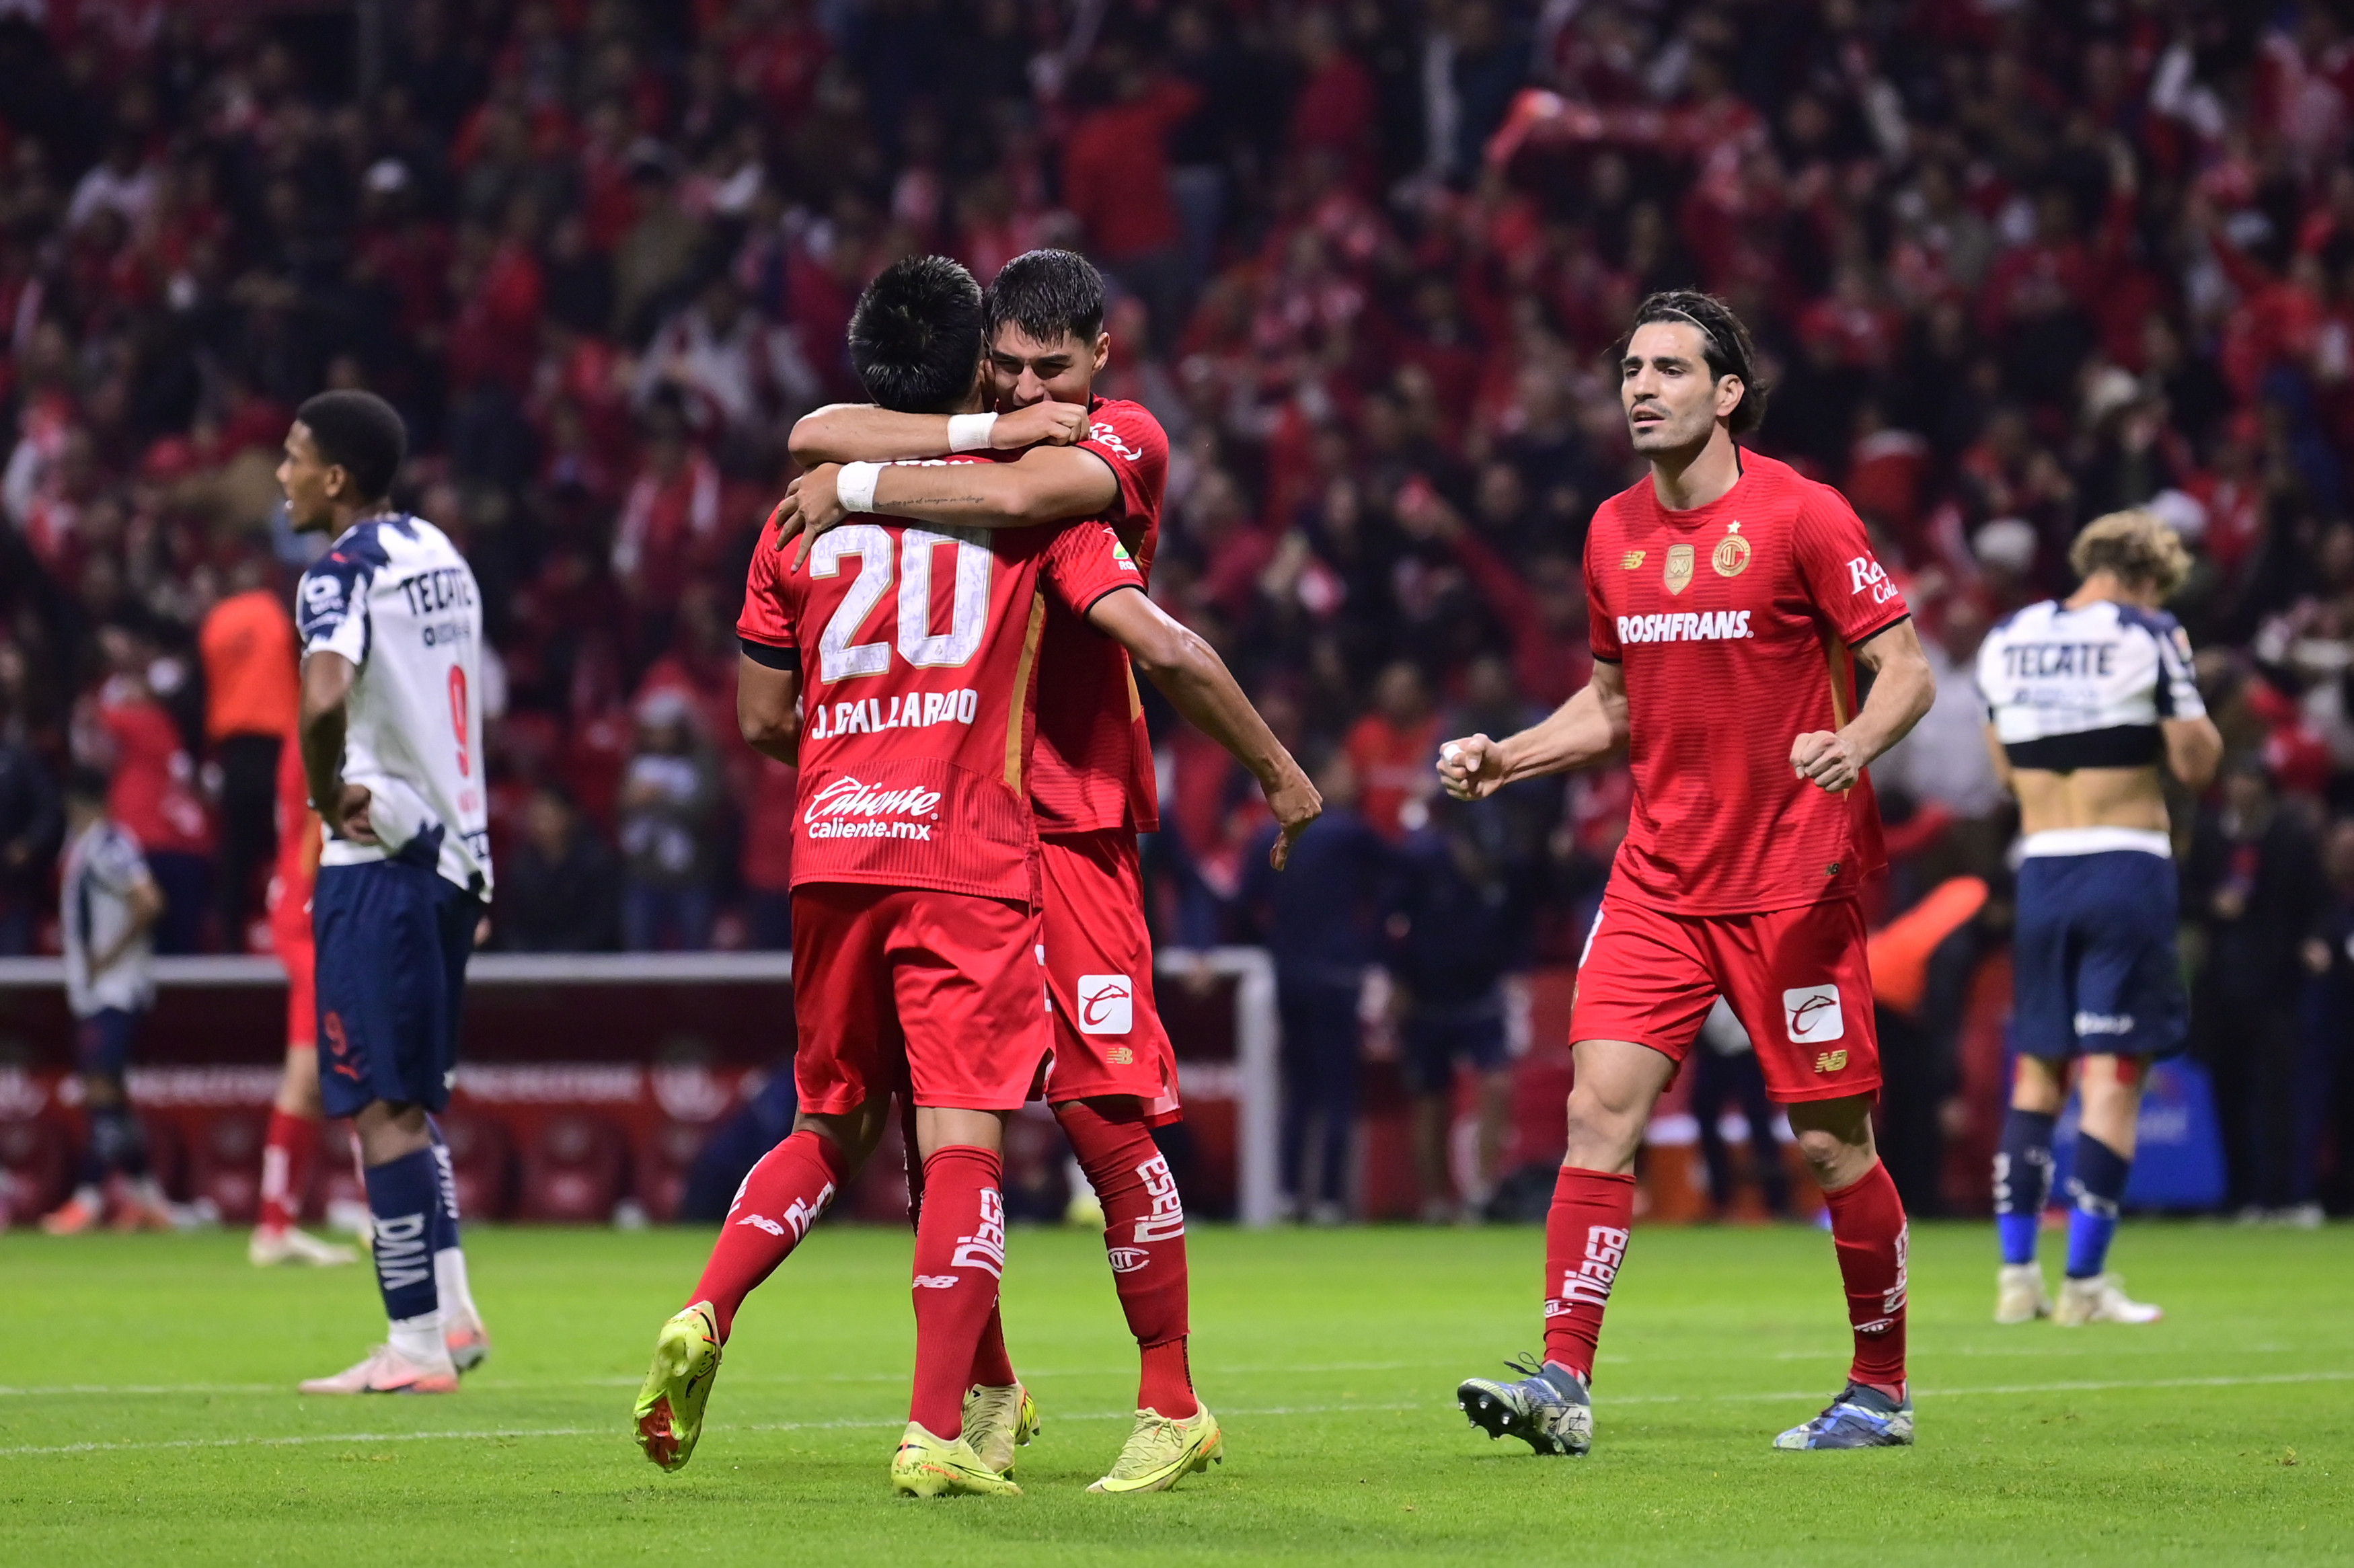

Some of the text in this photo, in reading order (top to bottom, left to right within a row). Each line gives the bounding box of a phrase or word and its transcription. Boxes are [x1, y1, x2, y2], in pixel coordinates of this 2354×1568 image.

[810, 521, 993, 684] 20
[1873, 577, 1898, 604] Cola
[1617, 611, 1751, 644] ROSHFRANS
[2003, 642, 2117, 675] TECATE
[811, 688, 979, 740] J.GALLARDO
[804, 775, 942, 824] Caliente
[808, 817, 932, 841] caliente.mx
[324, 1011, 348, 1056] 9
